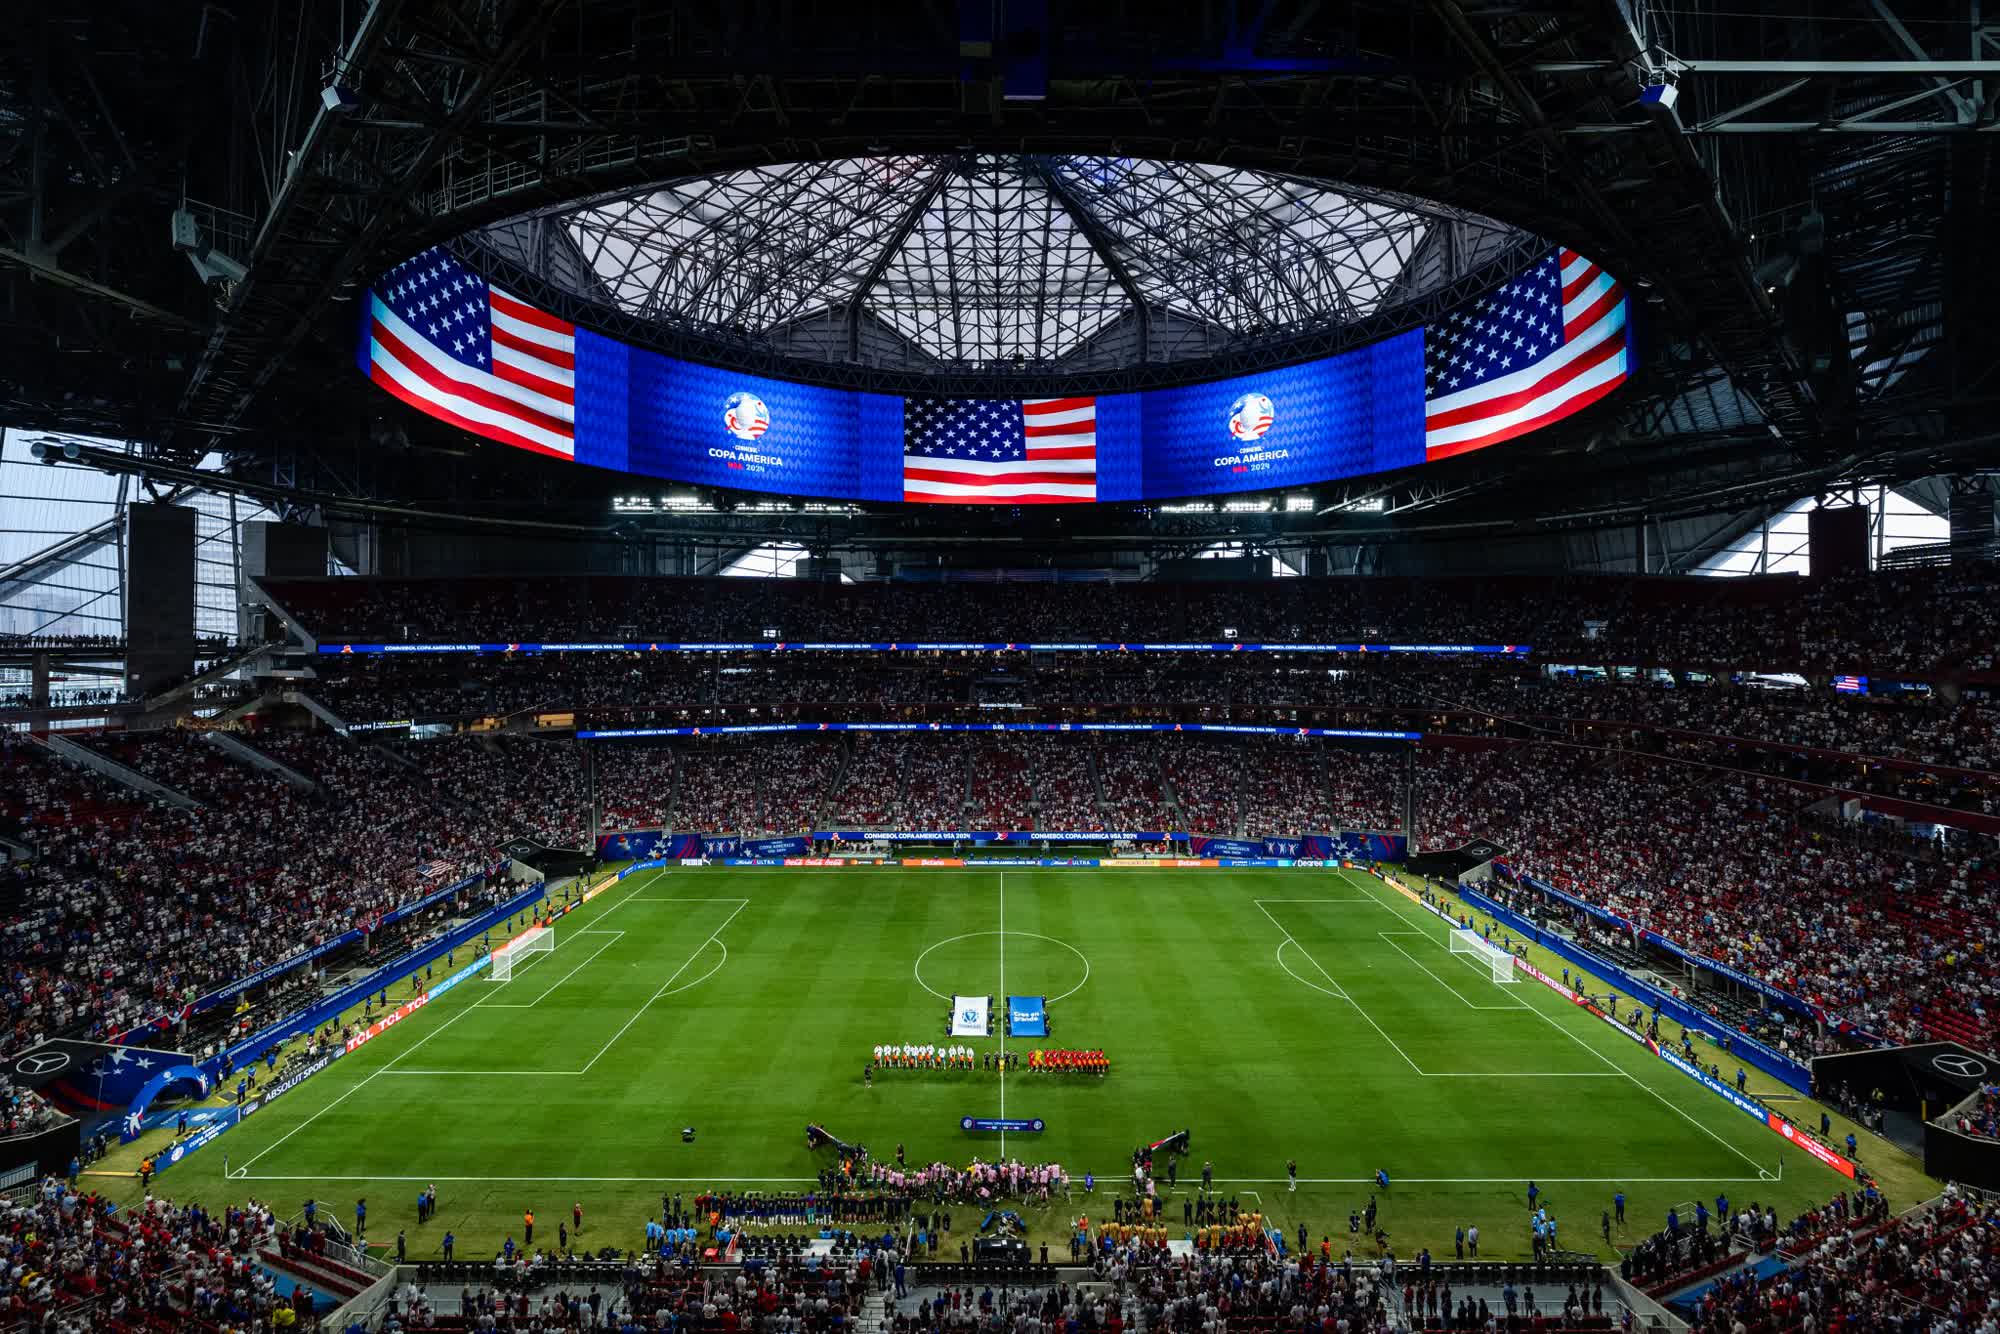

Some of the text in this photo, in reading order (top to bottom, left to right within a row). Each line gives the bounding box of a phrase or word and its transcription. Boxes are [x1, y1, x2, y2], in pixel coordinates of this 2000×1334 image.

[709, 448, 783, 466] COPA AMERICA
[746, 464, 765, 472] 2024
[1214, 449, 1288, 466] COPA AMERICA
[1251, 463, 1270, 471] 2024
[218, 975, 262, 999] CONMEBOL
[263, 966, 282, 978] COPA
[282, 952, 313, 971] AMERICA
[1695, 956, 1714, 968] COPA
[1715, 965, 1748, 984] AMERICA
[1749, 978, 1763, 989] USA
[1764, 986, 1784, 1000] 2024
[347, 995, 428, 1051] TCL TCL TCL
[265, 1056, 329, 1103] ABSOLUT SPORT
[1662, 1050, 1766, 1121] CONMEBOL Cree en grande.
